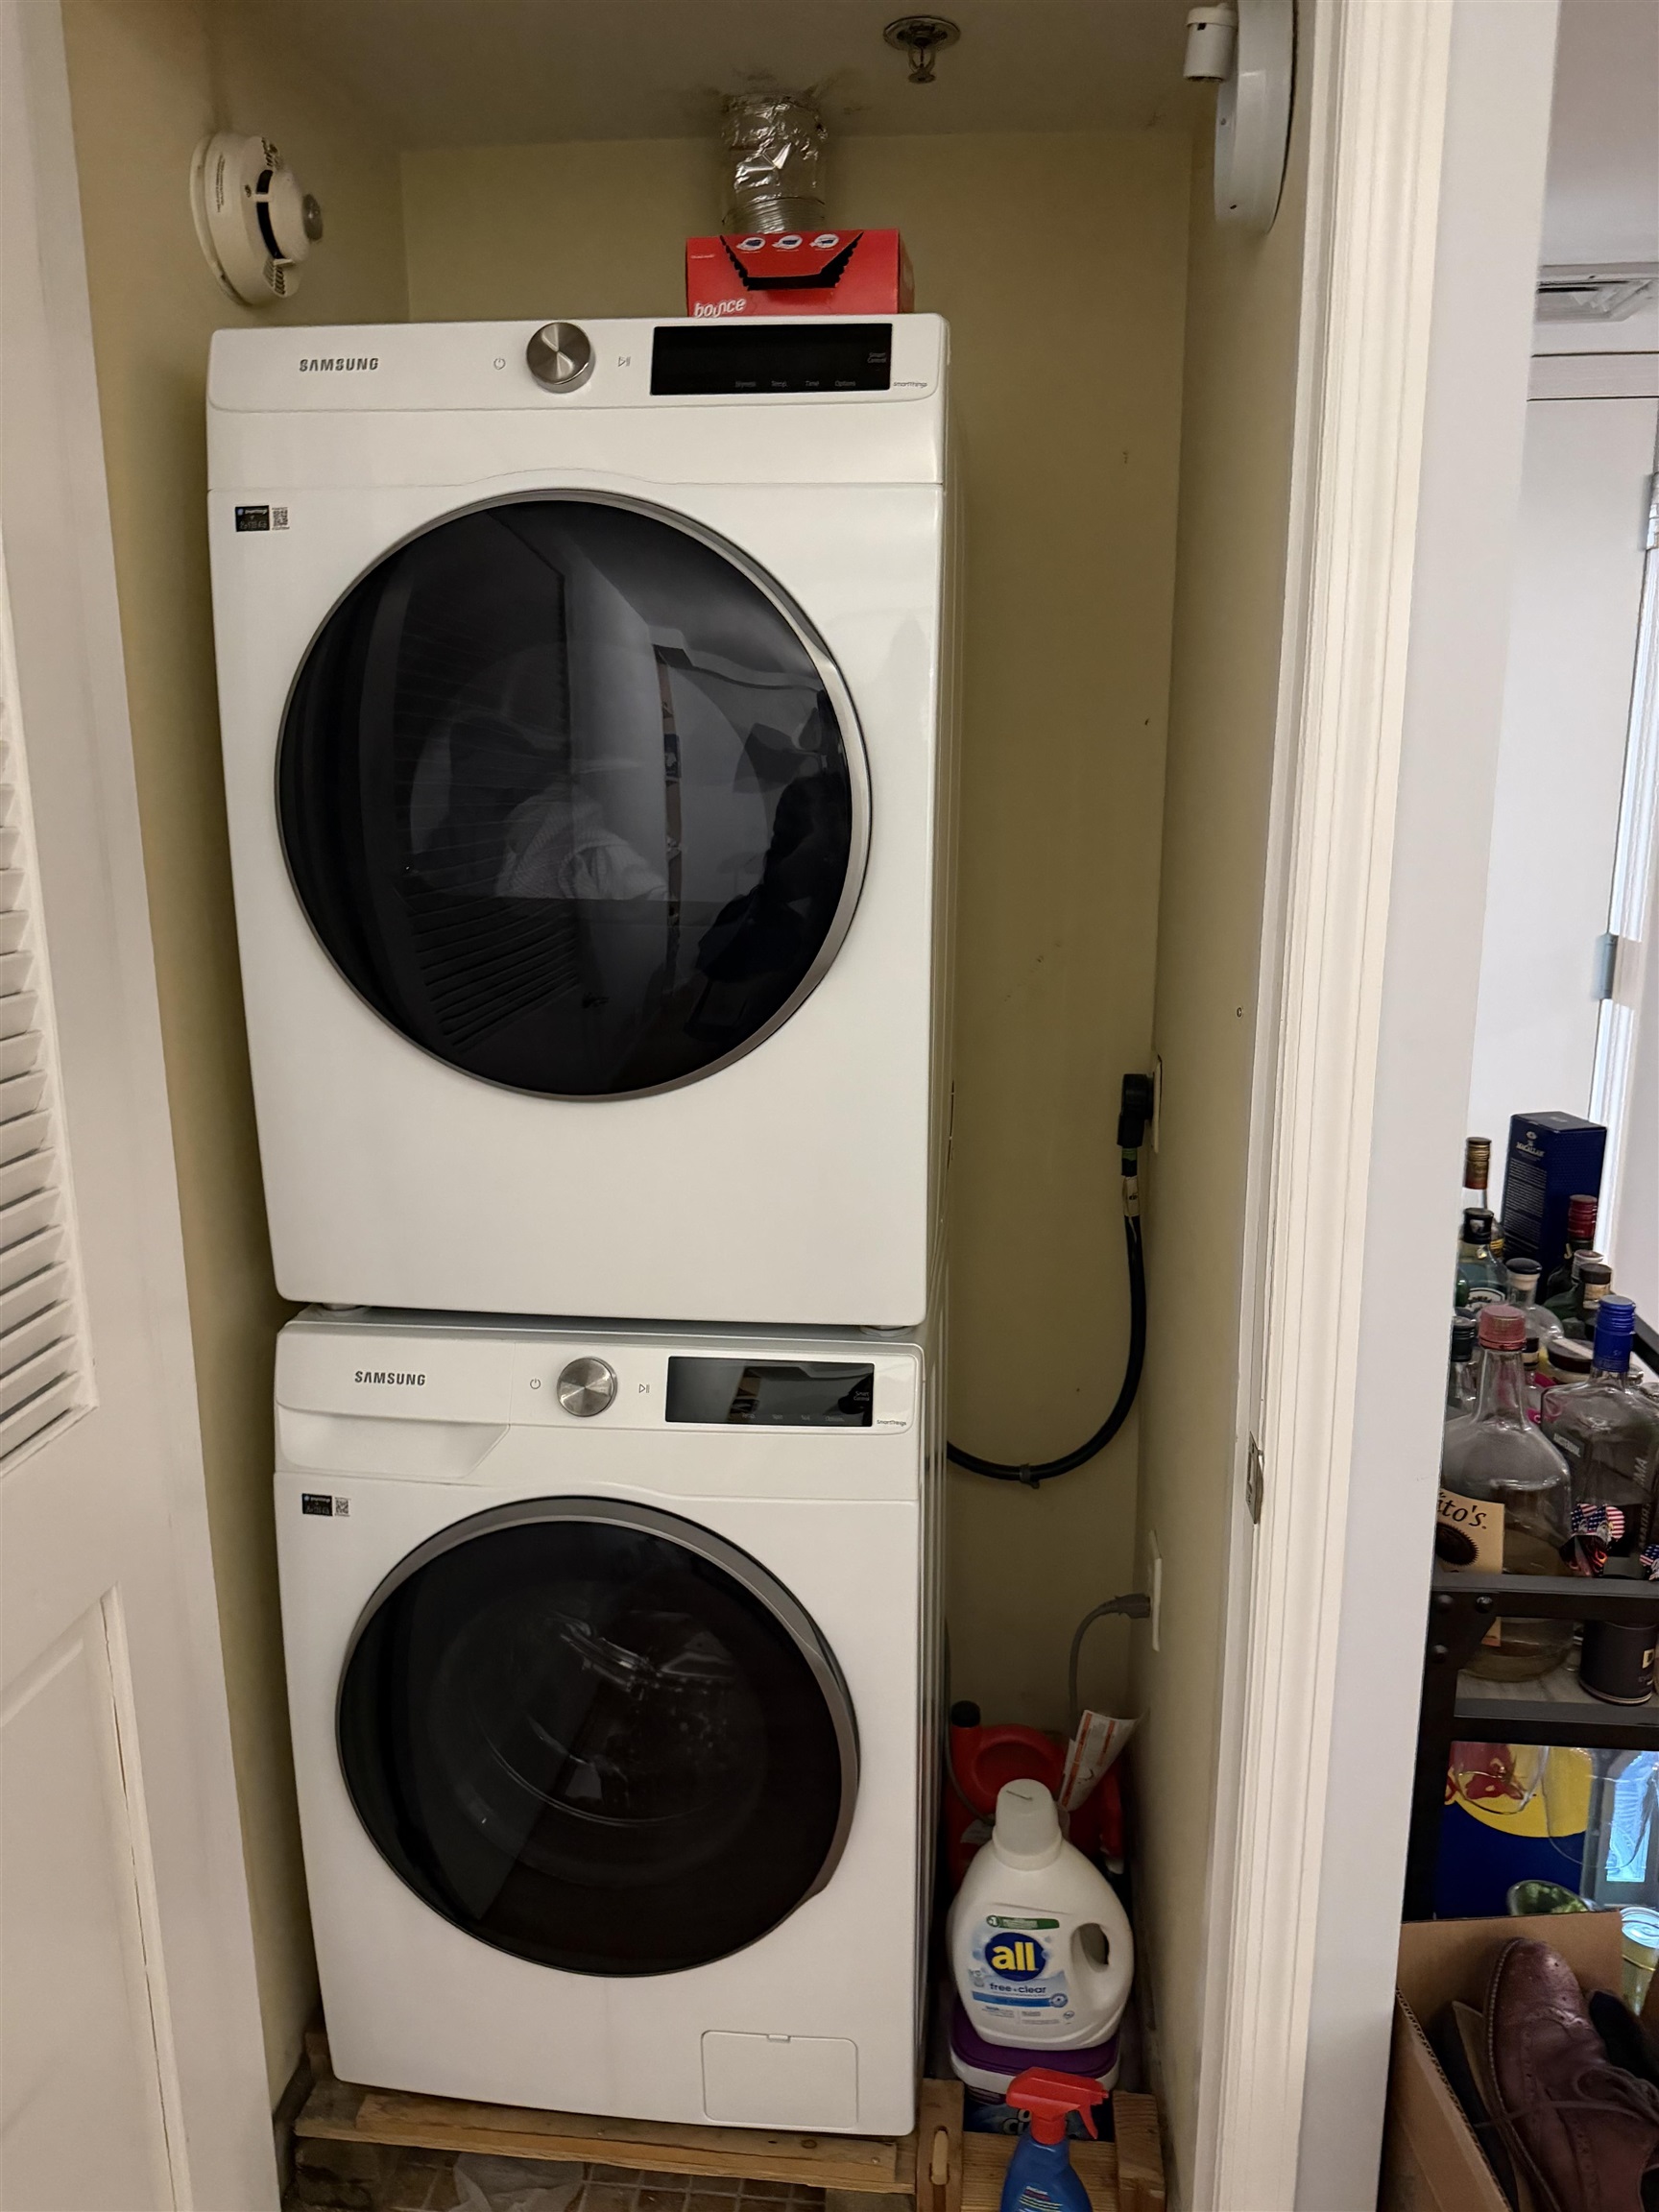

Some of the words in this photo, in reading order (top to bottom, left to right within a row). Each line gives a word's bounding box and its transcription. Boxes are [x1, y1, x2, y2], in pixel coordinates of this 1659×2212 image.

[693, 298, 747, 318] bounce
[299, 358, 379, 372] SAMSUNG
[354, 1370, 425, 1385] SAMSUNG
[991, 1941, 1036, 1971] all
[990, 1983, 1012, 1992] free
[1018, 1985, 1046, 1994] clear
